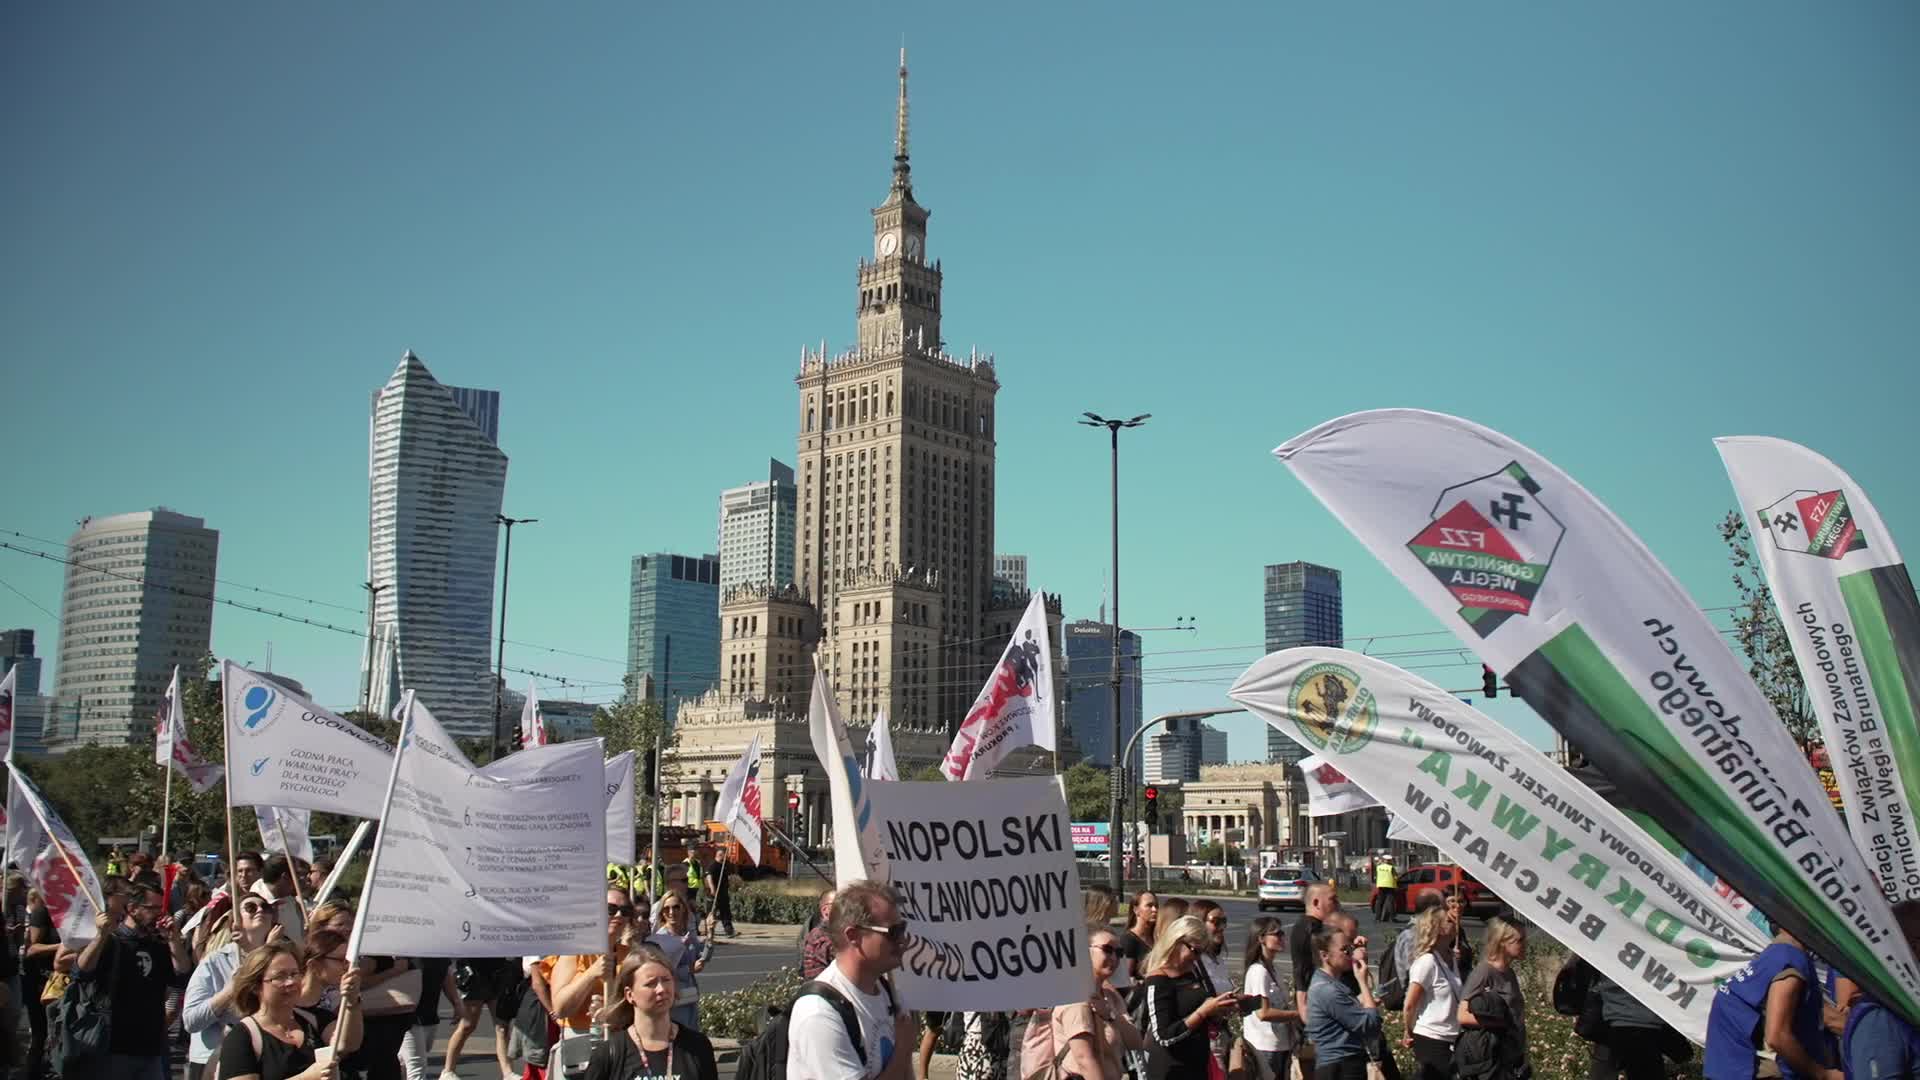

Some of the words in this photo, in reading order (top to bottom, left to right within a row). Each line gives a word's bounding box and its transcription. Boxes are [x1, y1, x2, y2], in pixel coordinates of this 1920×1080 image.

[1809, 498, 1830, 523] FZZ
[1796, 602, 1853, 725] Zawodowych
[1831, 623, 1878, 733] Brunatnego
[290, 748, 325, 763] GODNA
[1868, 737, 1897, 799] Węgla
[282, 770, 299, 781] DLA
[285, 759, 328, 775] WARUNKI
[329, 766, 360, 779] PRACY
[1843, 728, 1880, 823] Związków
[280, 782, 340, 798] PSYCHOLOGA
[887, 813, 1063, 861] NOPOLSKI
[465, 846, 475, 867] 7.
[920, 870, 1068, 922] ZAWODOWY
[462, 920, 476, 941] 9.
